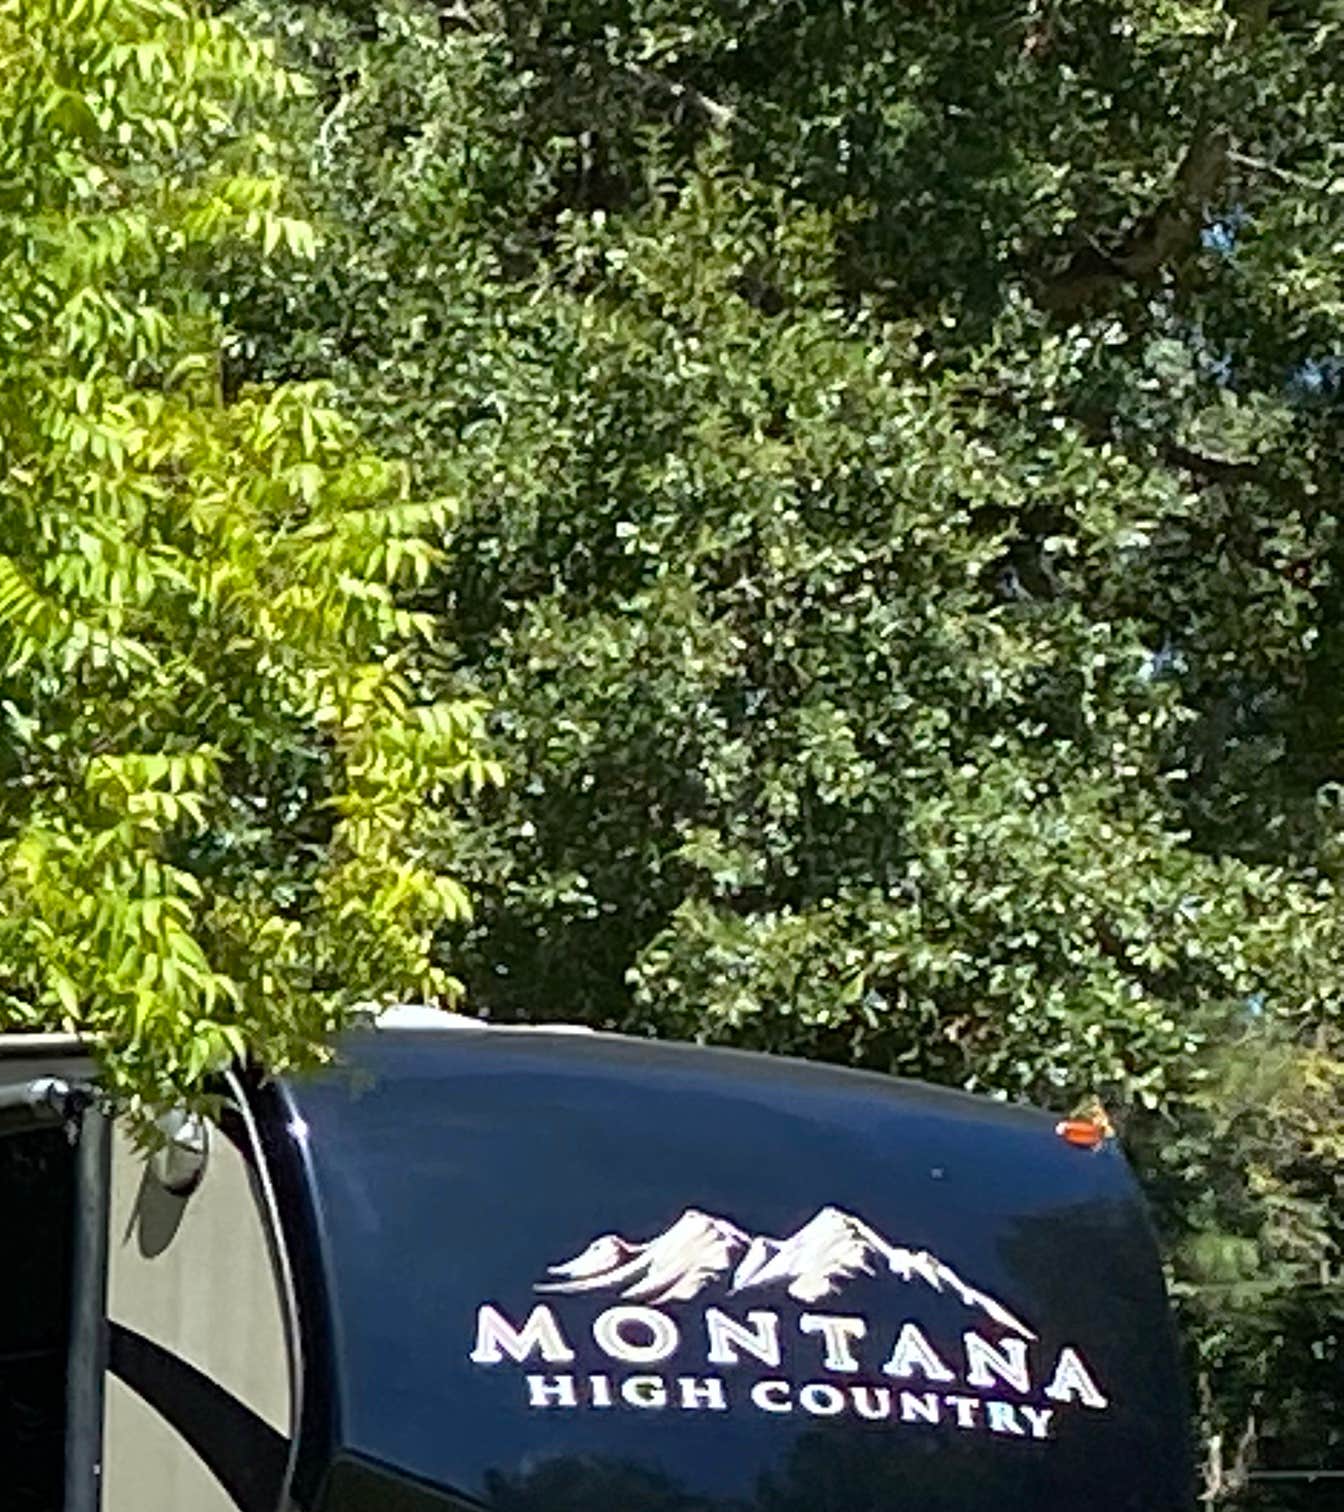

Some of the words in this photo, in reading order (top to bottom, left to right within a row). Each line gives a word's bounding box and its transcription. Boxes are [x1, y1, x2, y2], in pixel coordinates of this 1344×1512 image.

[470, 1304, 1108, 1409] MONTANA
[527, 1374, 727, 1411] HIGH
[751, 1379, 1055, 1439] COUNTRY
